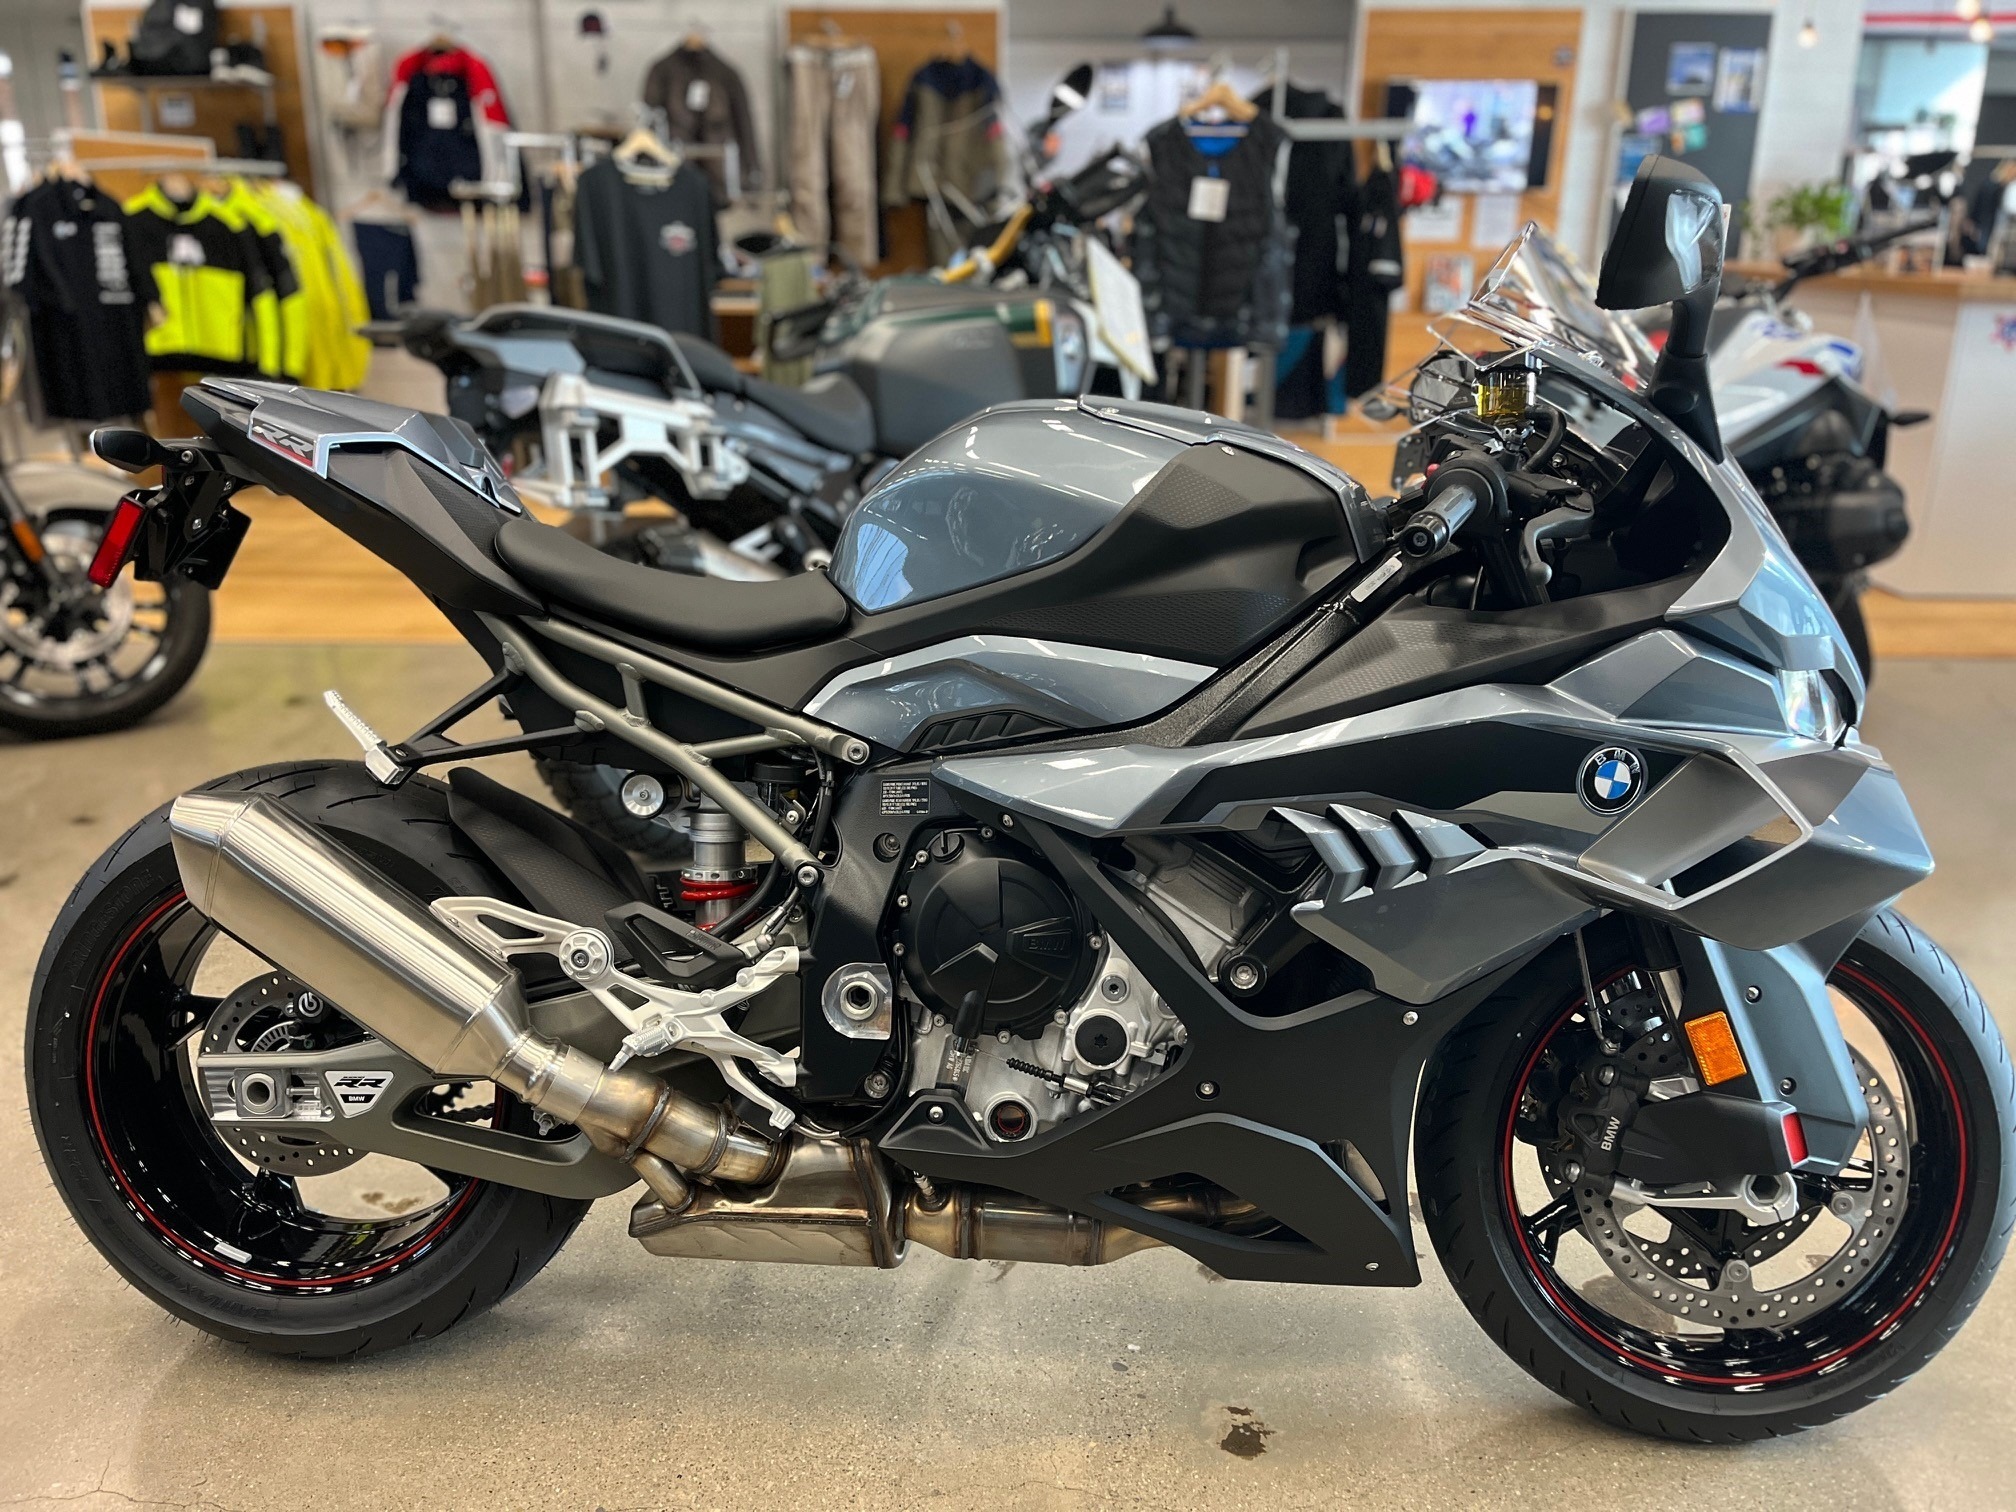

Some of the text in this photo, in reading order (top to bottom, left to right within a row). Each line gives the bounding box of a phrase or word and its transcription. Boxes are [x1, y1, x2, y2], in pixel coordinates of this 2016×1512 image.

[252, 423, 314, 458] RR
[1594, 749, 1640, 774] BMW
[334, 1078, 386, 1088] RR
[1600, 1116, 1621, 1151] BMW
